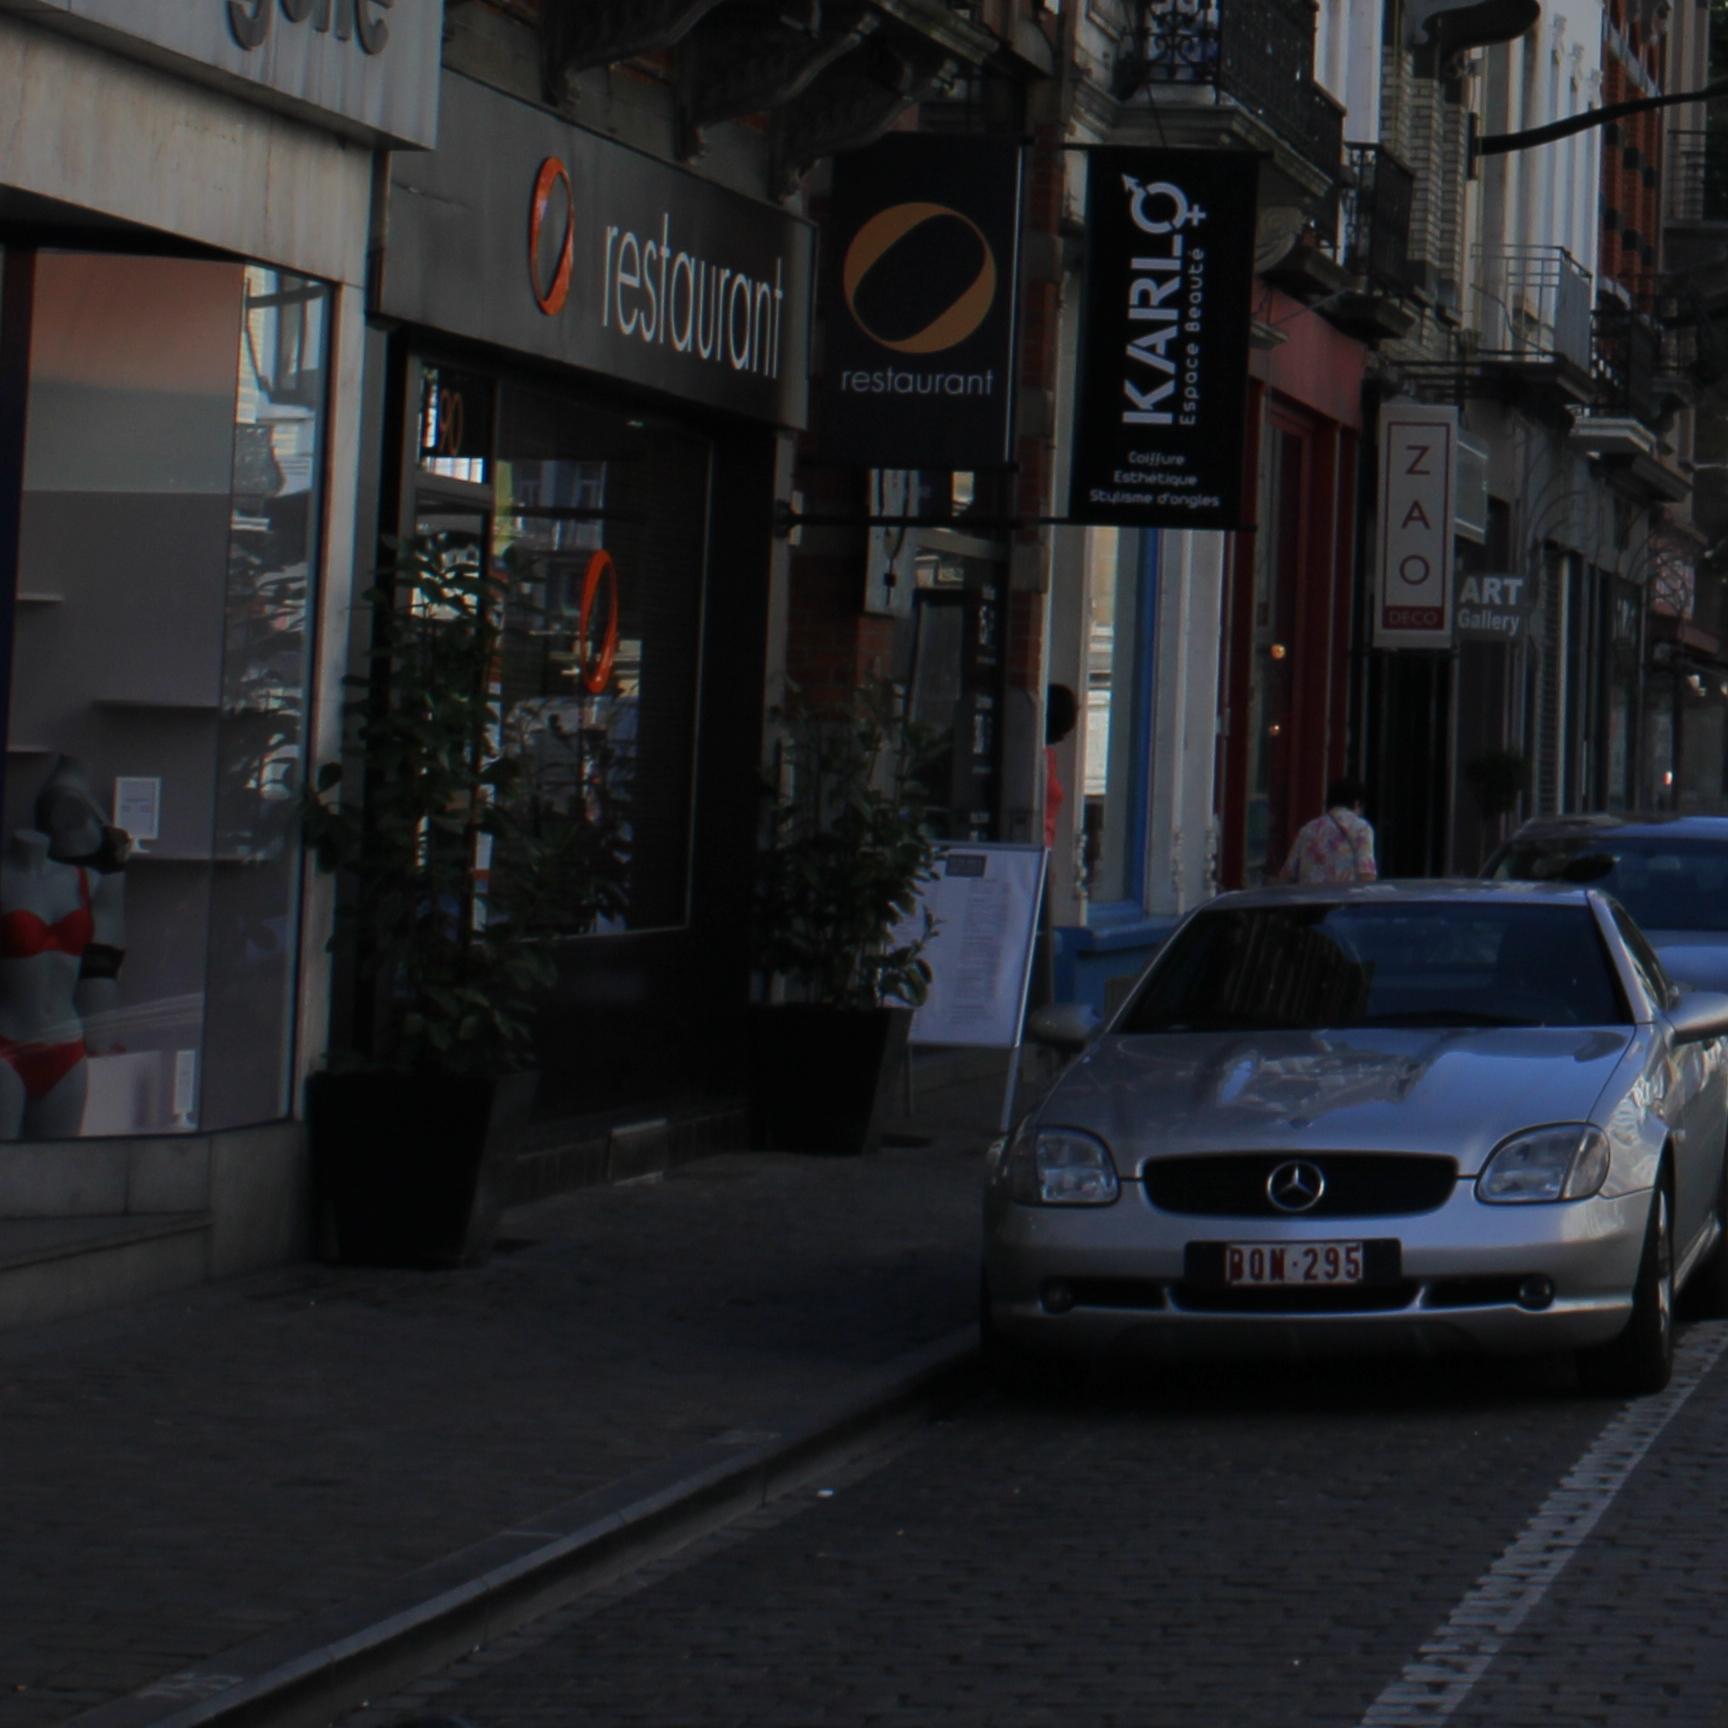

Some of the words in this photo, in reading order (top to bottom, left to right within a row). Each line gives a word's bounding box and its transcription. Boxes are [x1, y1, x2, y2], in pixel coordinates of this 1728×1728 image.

[602, 212, 783, 379] restaurant
[1121, 173, 1192, 425] KARLO
[1185, 247, 1206, 332] Beauté
[841, 368, 993, 396] restaurant
[1180, 342, 1200, 425] Espace
[1128, 450, 1185, 466] Coiffure
[1114, 470, 1198, 487] Esthétique
[1090, 489, 1154, 507] Stylisme
[1458, 576, 1524, 606] ART
[1458, 608, 1521, 636] Gallery
